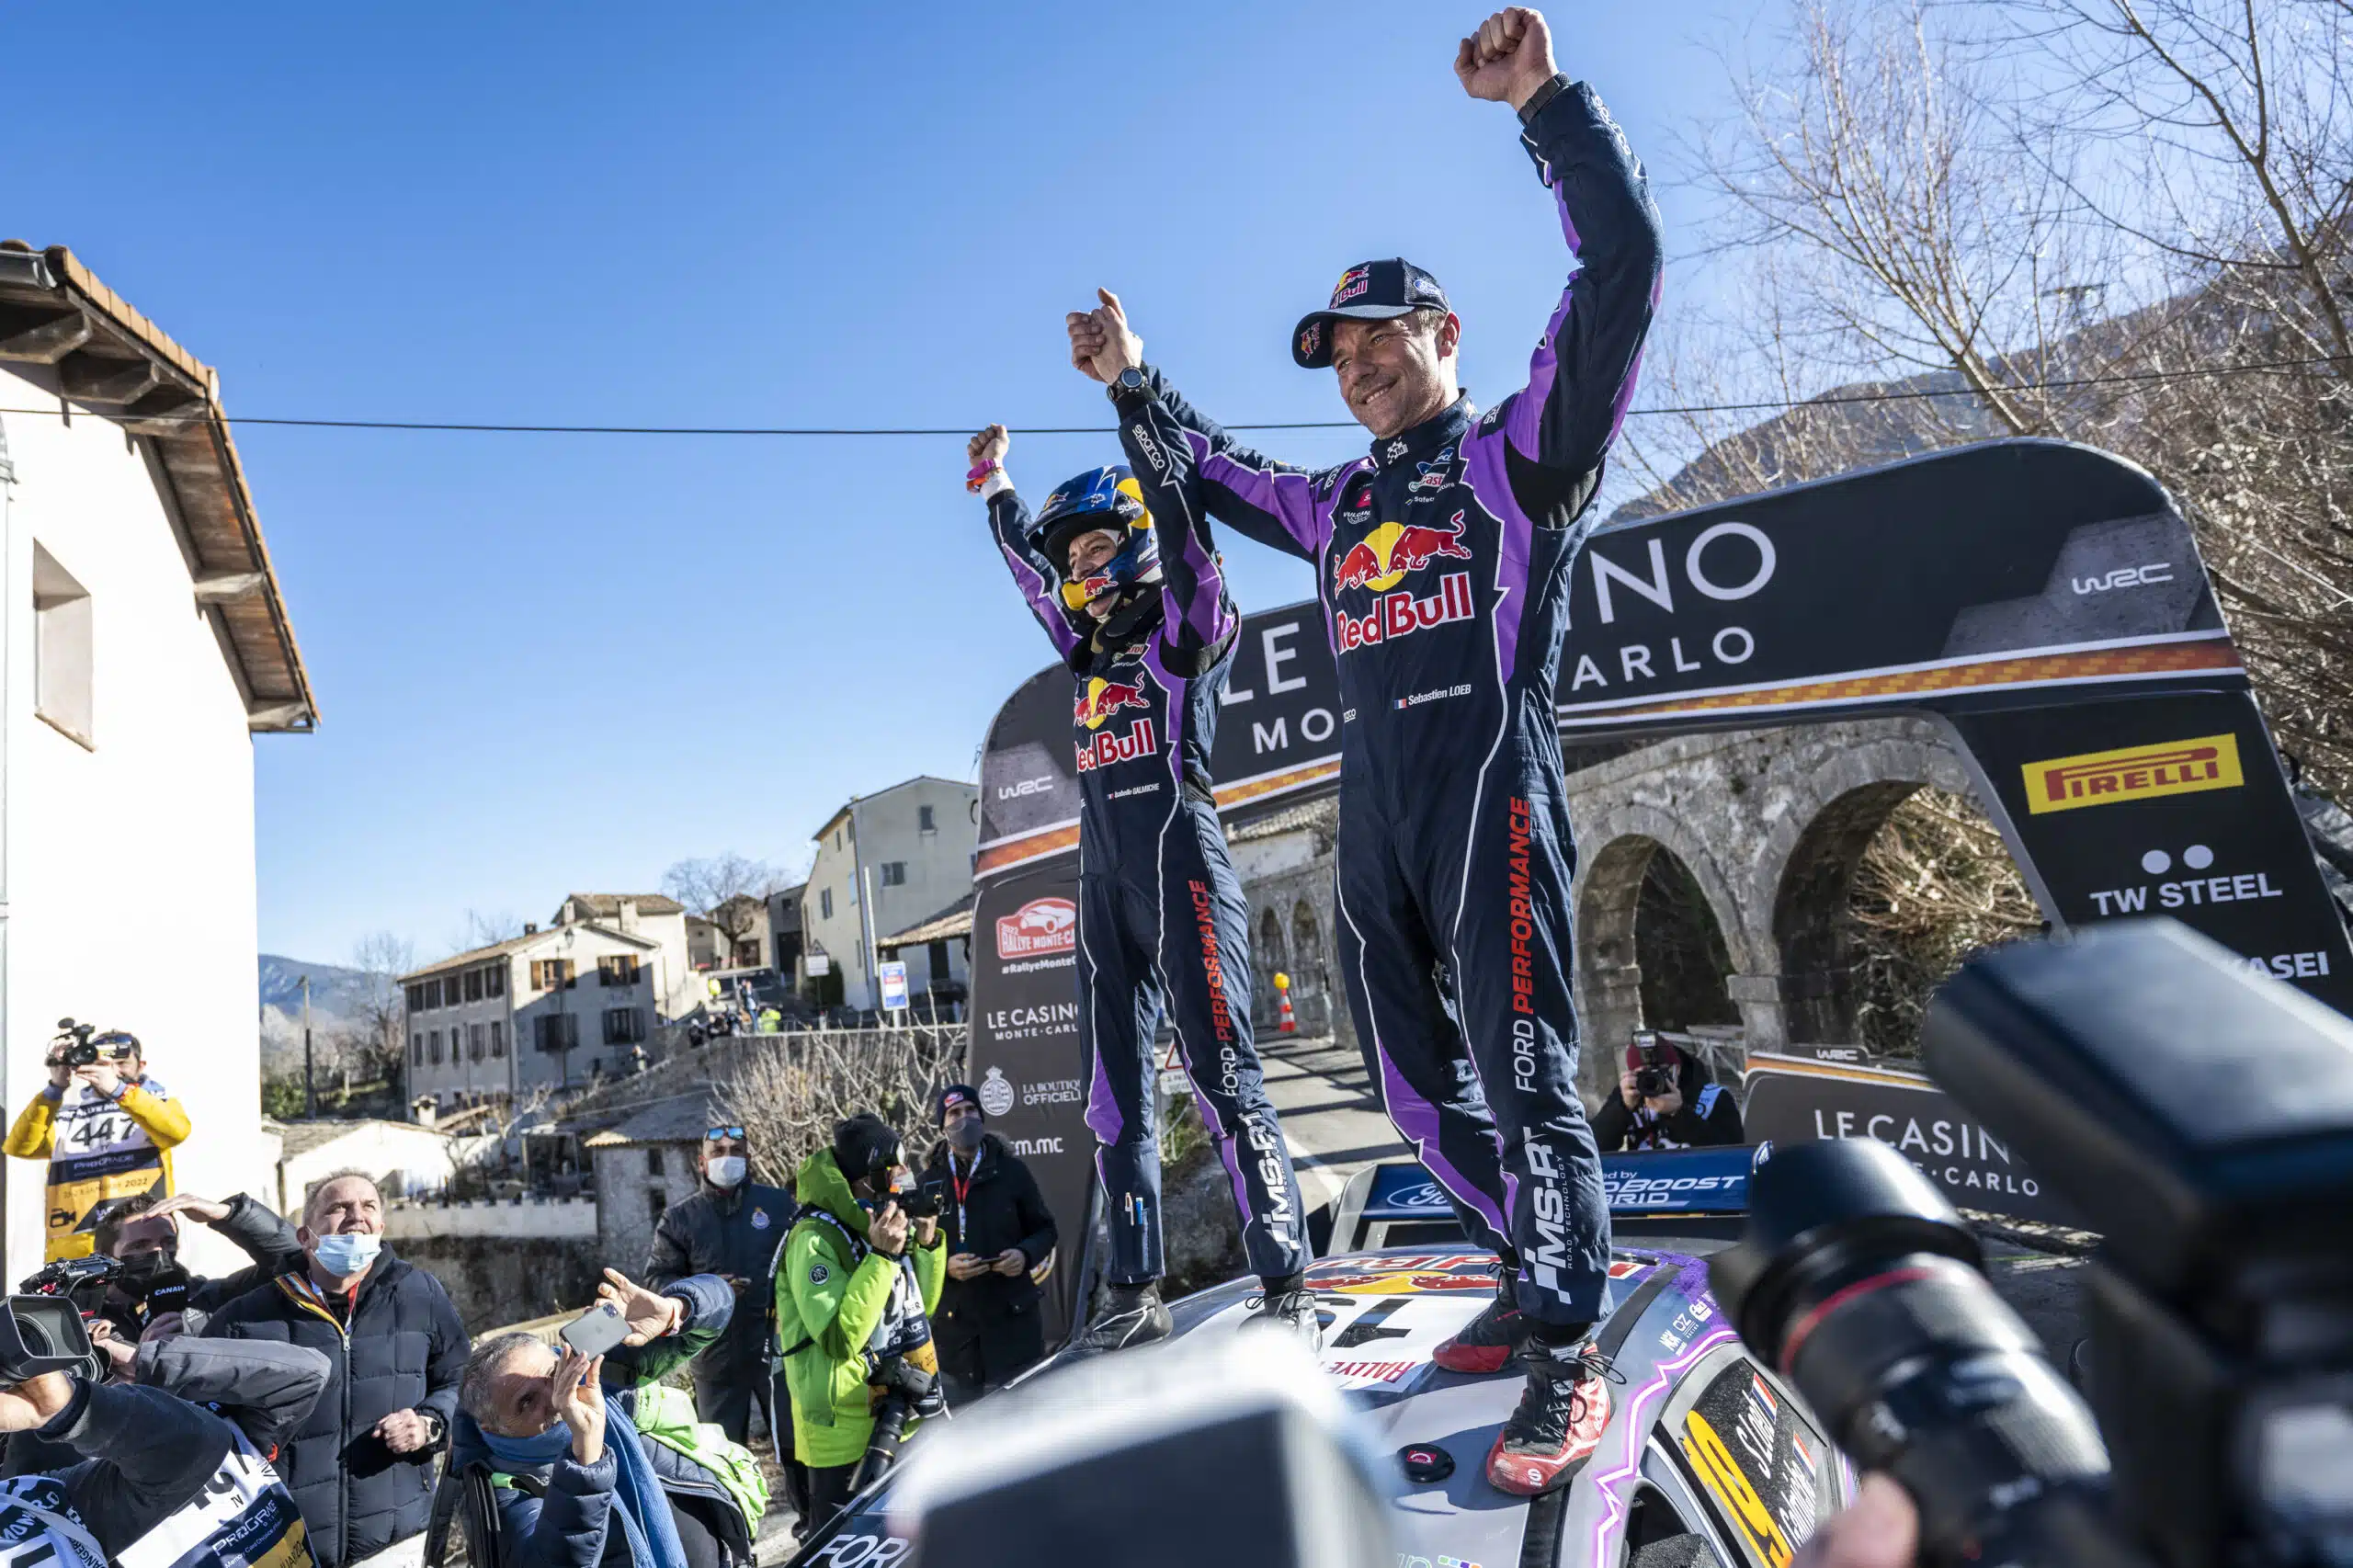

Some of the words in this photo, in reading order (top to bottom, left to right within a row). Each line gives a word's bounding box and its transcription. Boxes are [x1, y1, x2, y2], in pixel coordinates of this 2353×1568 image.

[1339, 280, 1368, 303] Bull
[1132, 425, 1165, 471] sparco
[1589, 522, 1776, 624] NO
[2072, 562, 2174, 595] WRC
[1336, 596, 1382, 655] Red
[1385, 571, 1475, 640] Bull
[1252, 708, 1335, 755] MO
[1572, 626, 1754, 691] ARLO
[1408, 689, 1448, 706] Sebastien
[1449, 684, 1472, 697] LOEB
[1075, 734, 1097, 774] ed
[1096, 717, 1157, 767] Bull
[998, 775, 1053, 800] WRC
[2044, 746, 2220, 801] PIRELLI
[1132, 783, 1160, 795] GALMICHE
[1508, 796, 1534, 1014] PERFORMANCE
[2089, 886, 2148, 915] TW
[2159, 873, 2283, 907] STEEL
[1002, 931, 1032, 952] RALLYE
[1188, 880, 1233, 1041] PERFORMANCE
[2234, 951, 2330, 980] ASEI
[987, 1011, 1007, 1029] LE
[1010, 1003, 1078, 1026] CASIN
[1514, 1018, 1538, 1093] FORD
[1816, 1049, 1858, 1061] WRC
[71, 1117, 135, 1146] 447
[1814, 1109, 1855, 1141] LE
[1604, 1176, 1745, 1192] OBOOST
[1620, 1171, 1637, 1180] by
[1556, 1154, 1572, 1233] TECHNOLOGY
[154, 1285, 186, 1296] CANAL+
[1327, 1361, 1416, 1383] RALLYE
